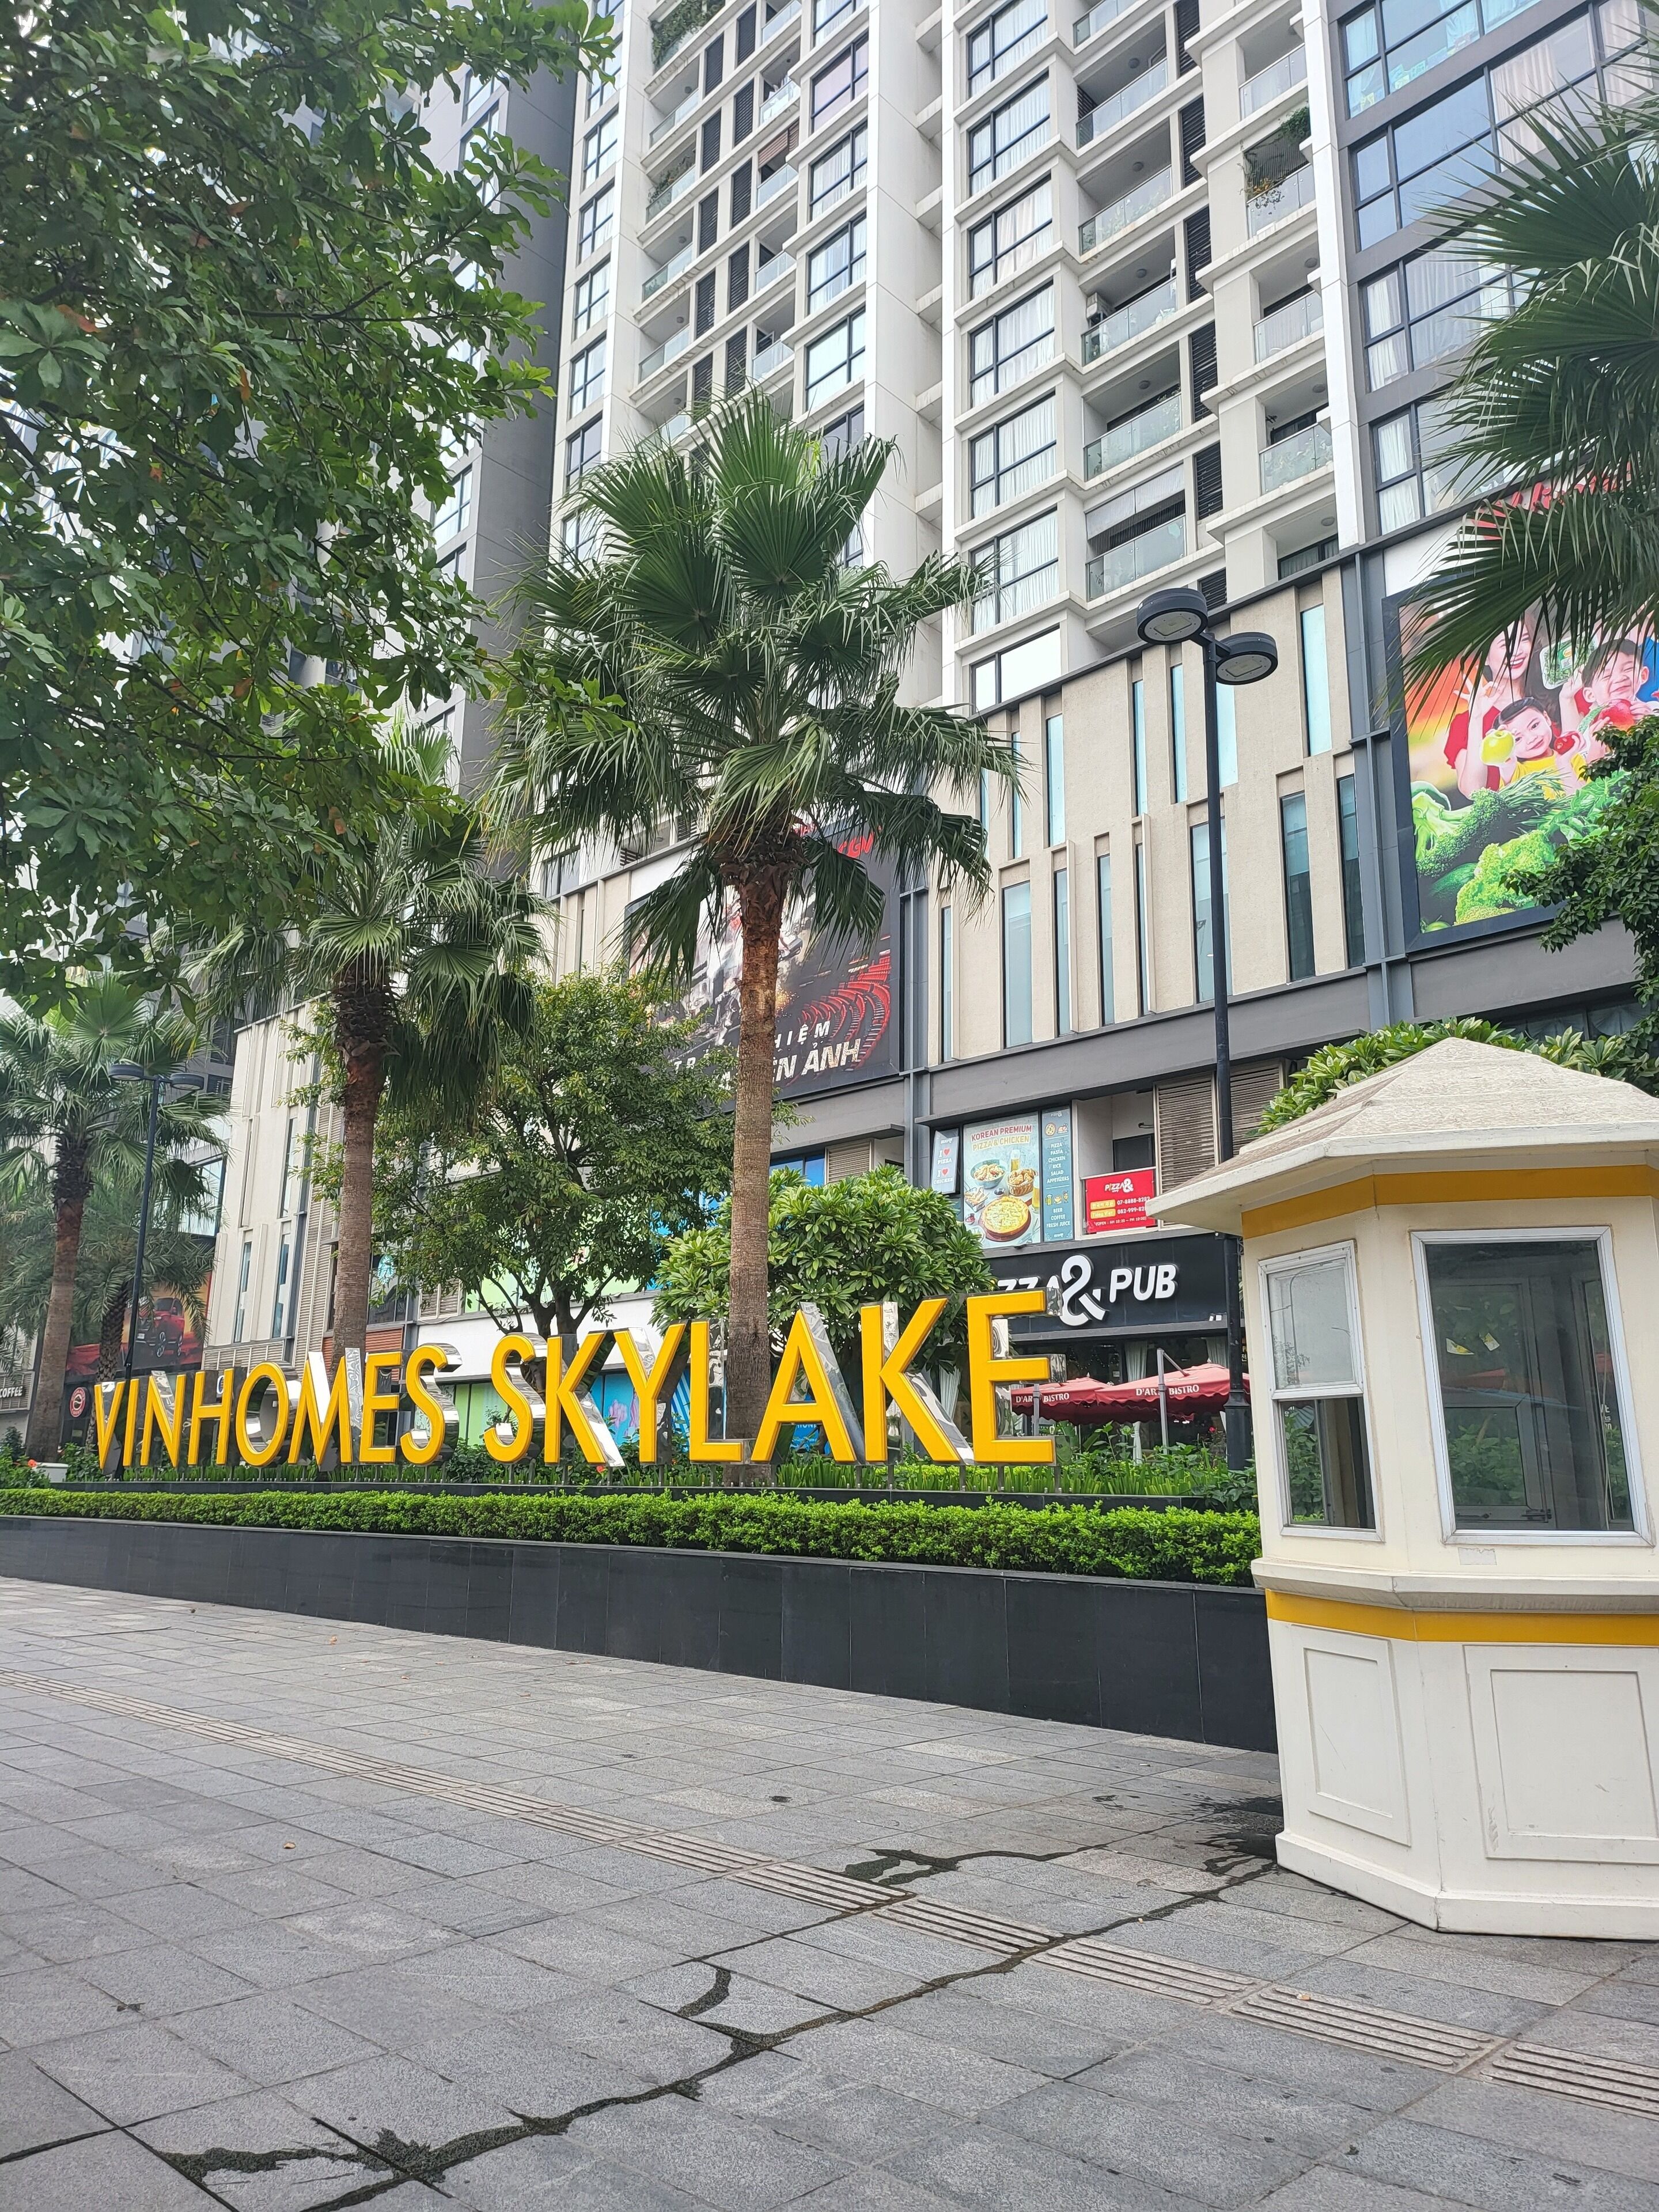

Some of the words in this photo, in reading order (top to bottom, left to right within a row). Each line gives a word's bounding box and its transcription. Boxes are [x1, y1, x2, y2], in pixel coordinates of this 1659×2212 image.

[971, 1128, 999, 1142] KOREAN
[1000, 1125, 1032, 1135] PREMIUM
[972, 1141, 993, 1152] PIZZA
[999, 1135, 1029, 1145] CHICKEN
[1109, 1264, 1177, 1304] PUB
[94, 1344, 449, 1470] VINHOMES
[484, 1290, 1055, 1464] SKYLAKE
[1043, 1392, 1070, 1403] BISTRO
[1169, 1384, 1200, 1396] BISTRO
